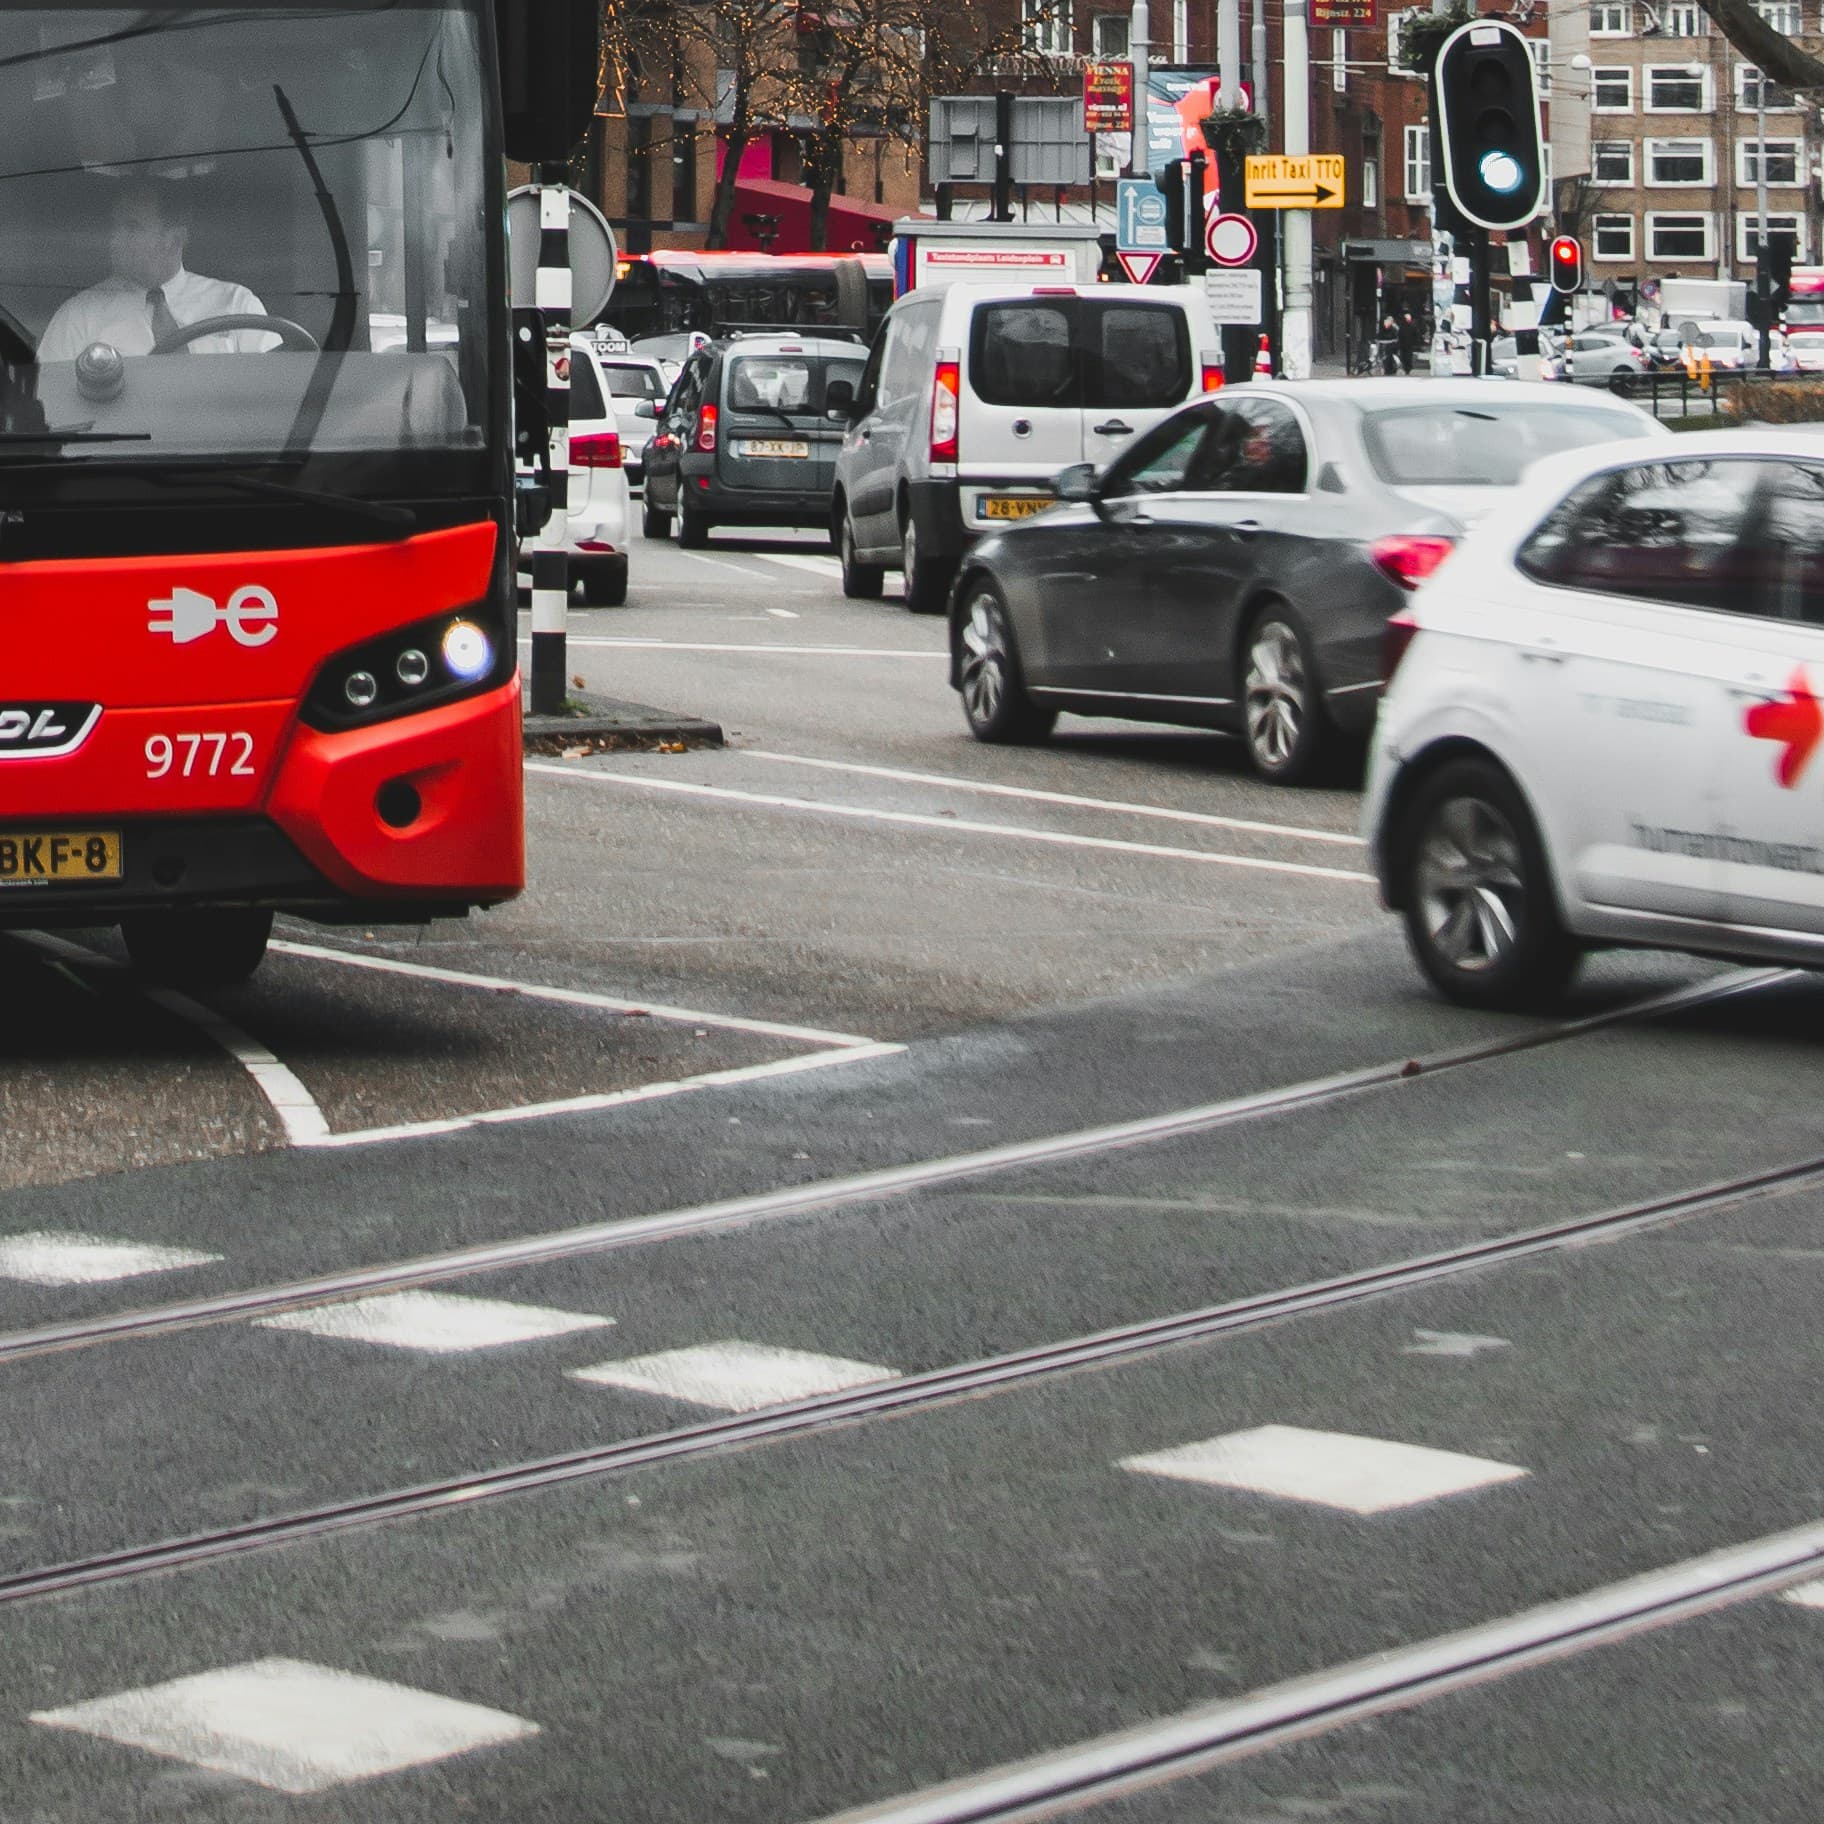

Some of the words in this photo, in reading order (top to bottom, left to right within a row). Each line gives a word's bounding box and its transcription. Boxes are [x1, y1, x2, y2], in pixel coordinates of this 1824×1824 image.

[1246, 159, 1277, 180] Inrit
[1281, 158, 1312, 180] Taxi
[144, 731, 255, 779] 9772
